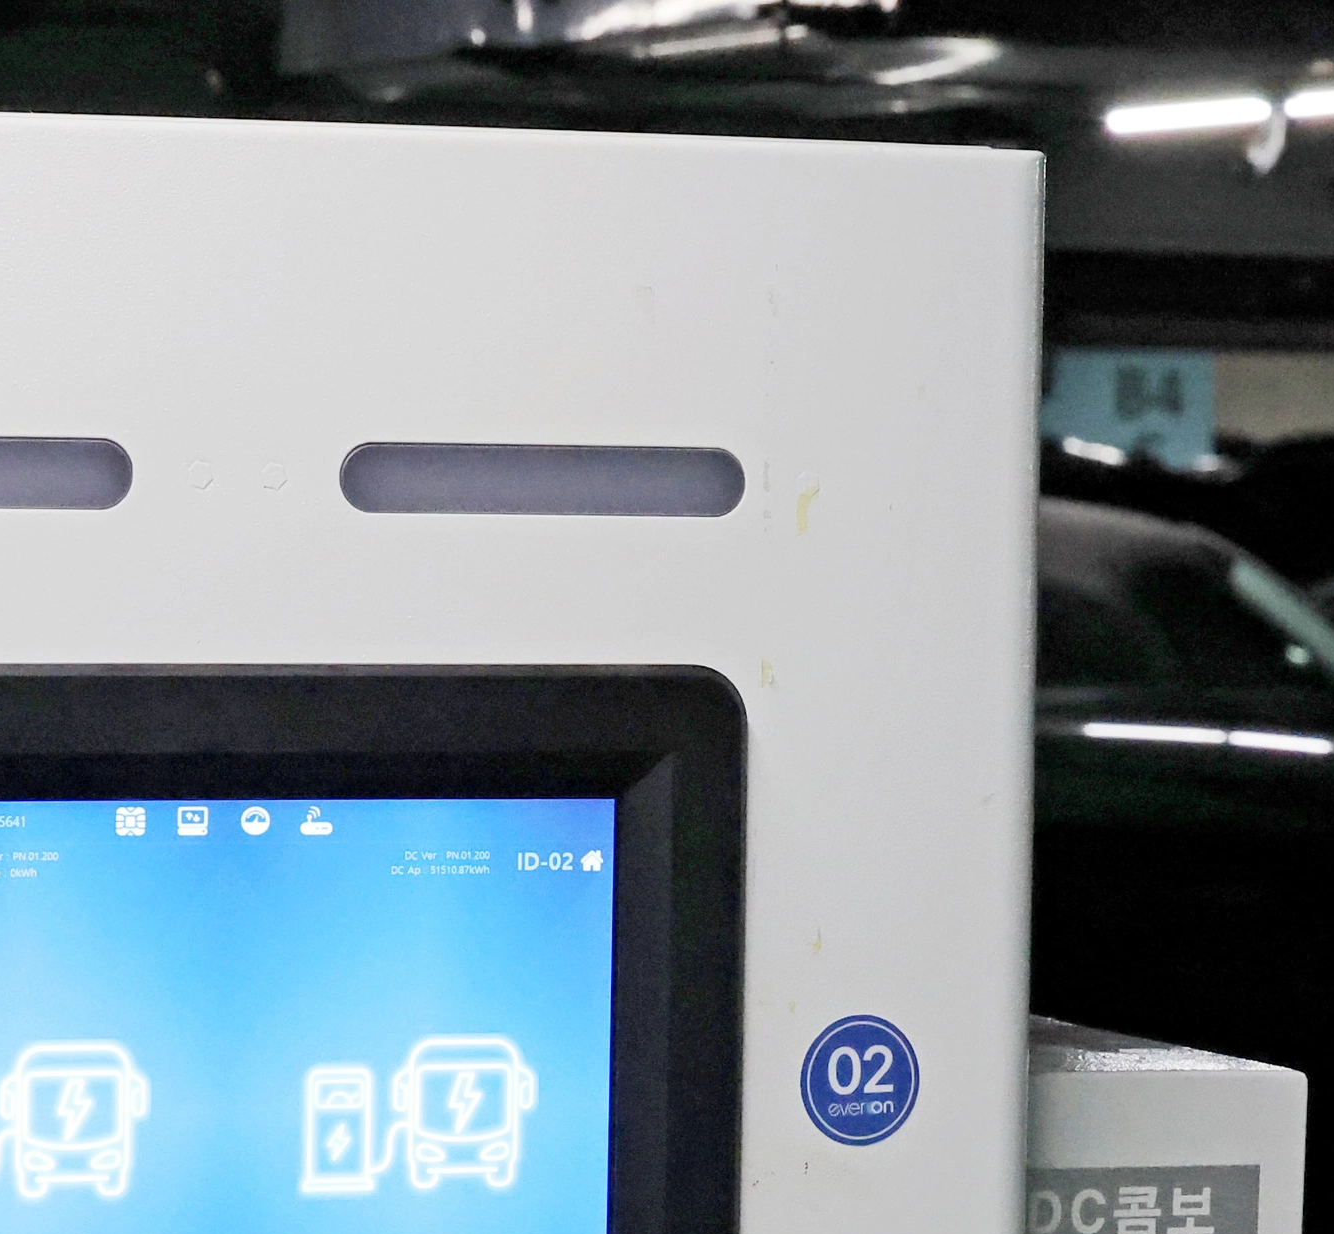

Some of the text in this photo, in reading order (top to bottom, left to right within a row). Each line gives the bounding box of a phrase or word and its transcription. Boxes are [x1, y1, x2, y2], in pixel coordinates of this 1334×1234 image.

[405, 851, 418, 861] DC
[421, 851, 437, 861] Ver
[517, 852, 574, 871] ID-02
[391, 866, 404, 875] DC
[828, 1044, 894, 1096] 02
